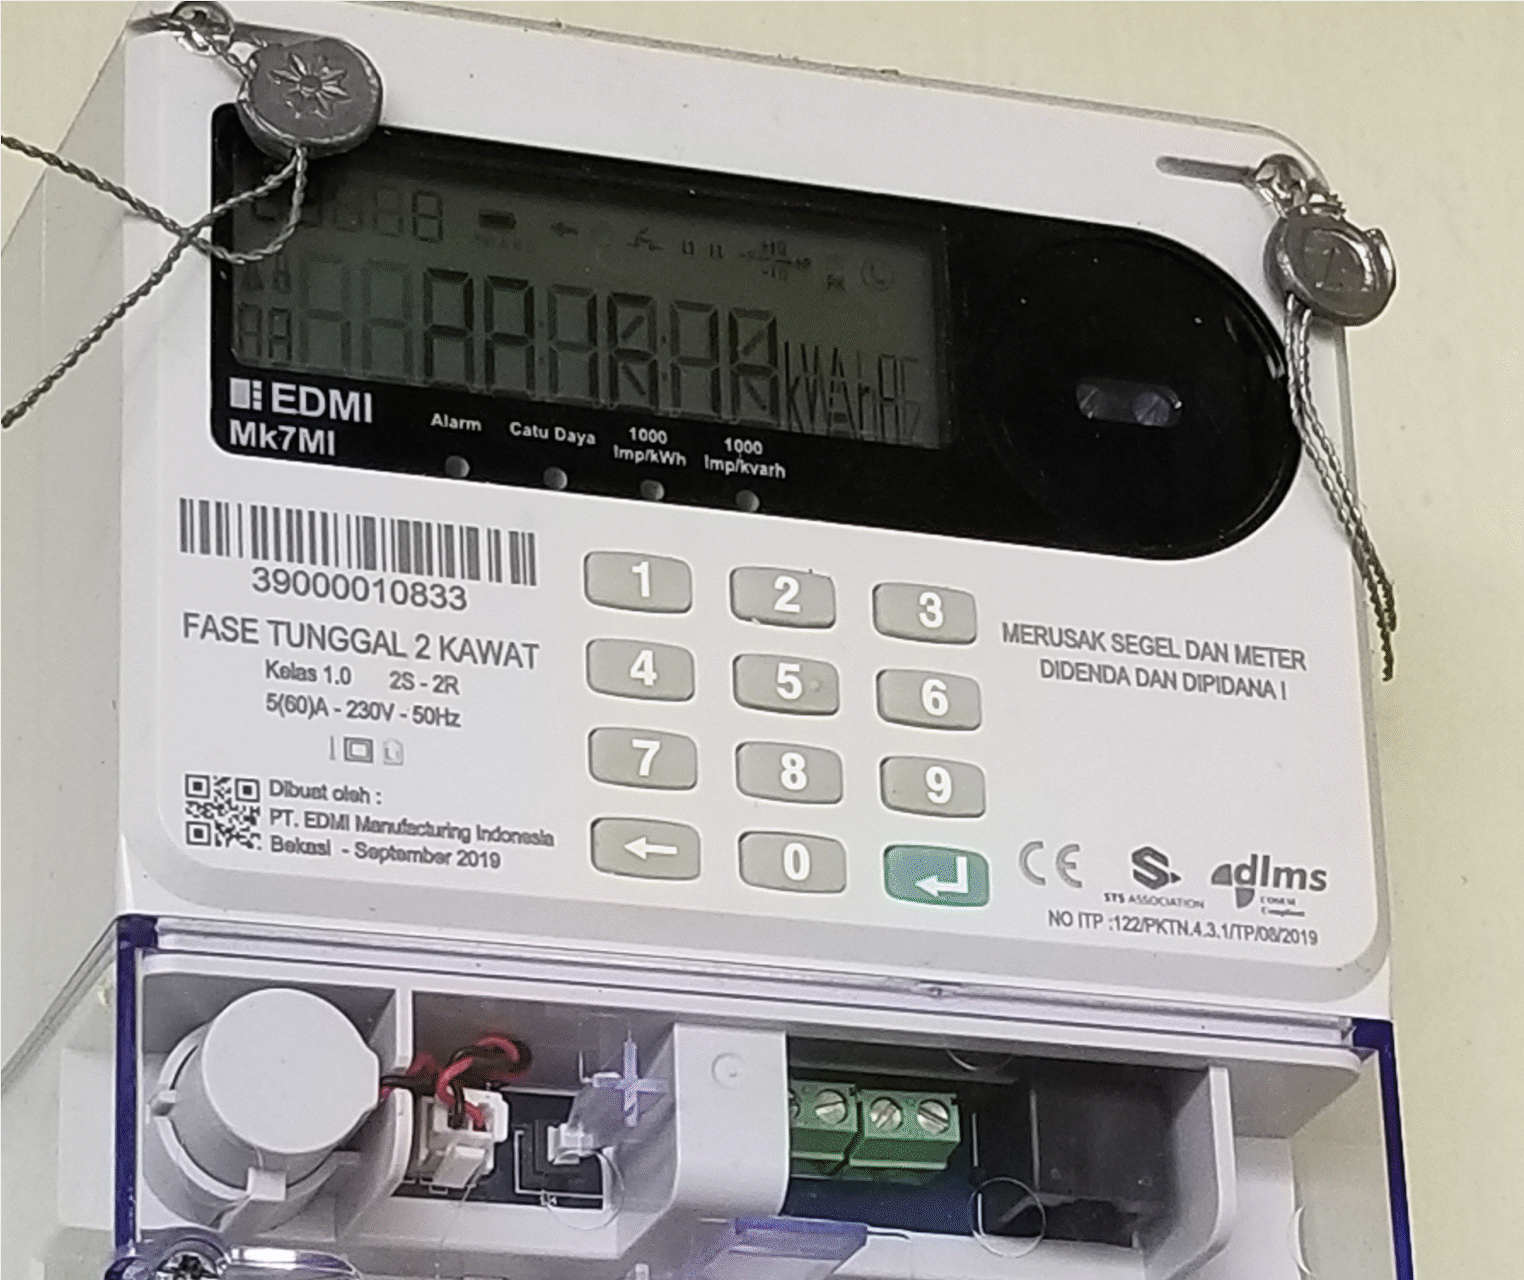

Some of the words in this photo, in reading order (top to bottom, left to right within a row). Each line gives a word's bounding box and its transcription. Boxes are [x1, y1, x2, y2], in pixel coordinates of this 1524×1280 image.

[272, 382, 372, 423] EDMI
[230, 419, 335, 456] Mk7MI
[430, 412, 483, 432] Alarm
[509, 421, 549, 440] Catu
[554, 426, 597, 447] Daya
[628, 426, 668, 446] 1000
[613, 444, 688, 468] Imp/kWh
[723, 437, 764, 456] 1000
[704, 454, 786, 480] Imp/kvarh
[251, 566, 468, 611] 39000010833
[631, 561, 652, 598] 1
[773, 575, 801, 613] 2
[918, 591, 944, 628] 3
[182, 611, 260, 644] FASE
[266, 618, 408, 658] TUNGGAL
[414, 632, 431, 660] 2
[438, 634, 540, 670] KAWAT
[1001, 622, 1107, 653] MERUSAK
[1110, 632, 1181, 660] SEGEL
[1185, 639, 1229, 664] DAN
[1235, 644, 1308, 672] METER
[264, 658, 318, 683] Kelas
[323, 666, 352, 686] 1.0
[389, 671, 416, 690] 2S
[432, 675, 460, 695] 2R
[629, 649, 657, 686] 4
[776, 663, 803, 700] 5
[1040, 659, 1131, 687] DIDENDA
[1135, 667, 1178, 691] DAN
[1182, 672, 1278, 700] DIPIDANA
[266, 693, 329, 720] 5(60)A
[346, 700, 396, 722] 230V
[412, 705, 462, 728] 50Hz
[920, 678, 949, 716] 6
[631, 739, 661, 777] 7
[780, 752, 808, 791] 8
[269, 779, 329, 801] Dibuat
[332, 785, 372, 804] oleh
[925, 765, 953, 804] 9
[269, 808, 300, 829] PT.
[304, 811, 351, 832] EDMI
[355, 814, 472, 844] Manufacturing
[476, 823, 556, 848] Indonesia
[270, 835, 332, 857] Bekasi
[354, 845, 453, 868] September
[456, 849, 502, 870] 2019
[782, 843, 811, 881] 0
[1233, 853, 1328, 892] dlms
[1048, 909, 1074, 928] NO
[1078, 912, 1104, 929] ITP
[1104, 892, 1126, 904] STS
[1128, 893, 1205, 910] ASSOCIATION
